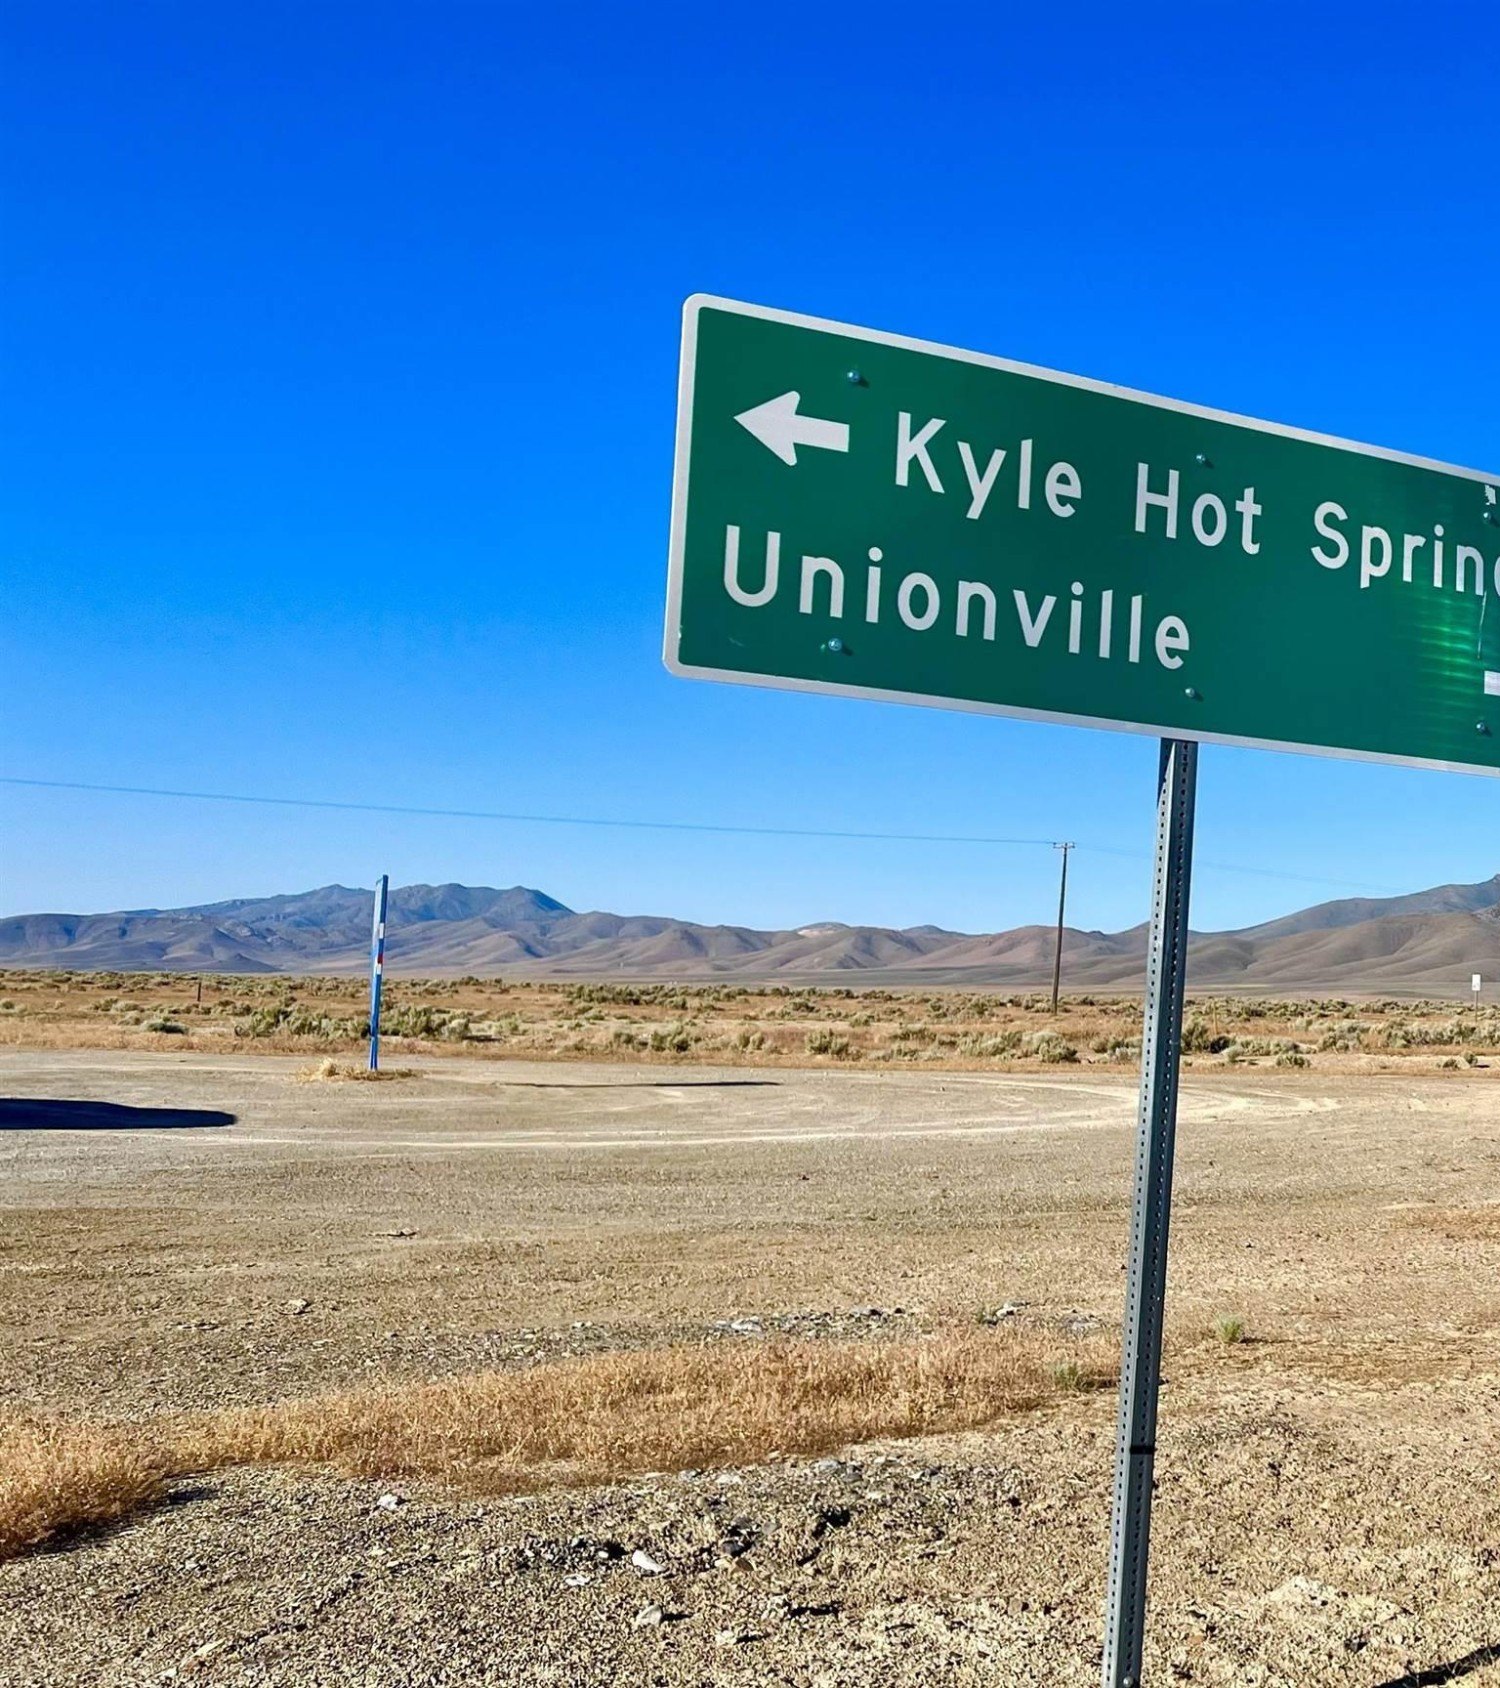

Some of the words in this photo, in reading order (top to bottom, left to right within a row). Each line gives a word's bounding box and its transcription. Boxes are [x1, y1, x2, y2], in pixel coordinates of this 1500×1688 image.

[893, 411, 1083, 520] Kyle
[1135, 462, 1263, 556] Hot
[722, 524, 1191, 671] Unionville
